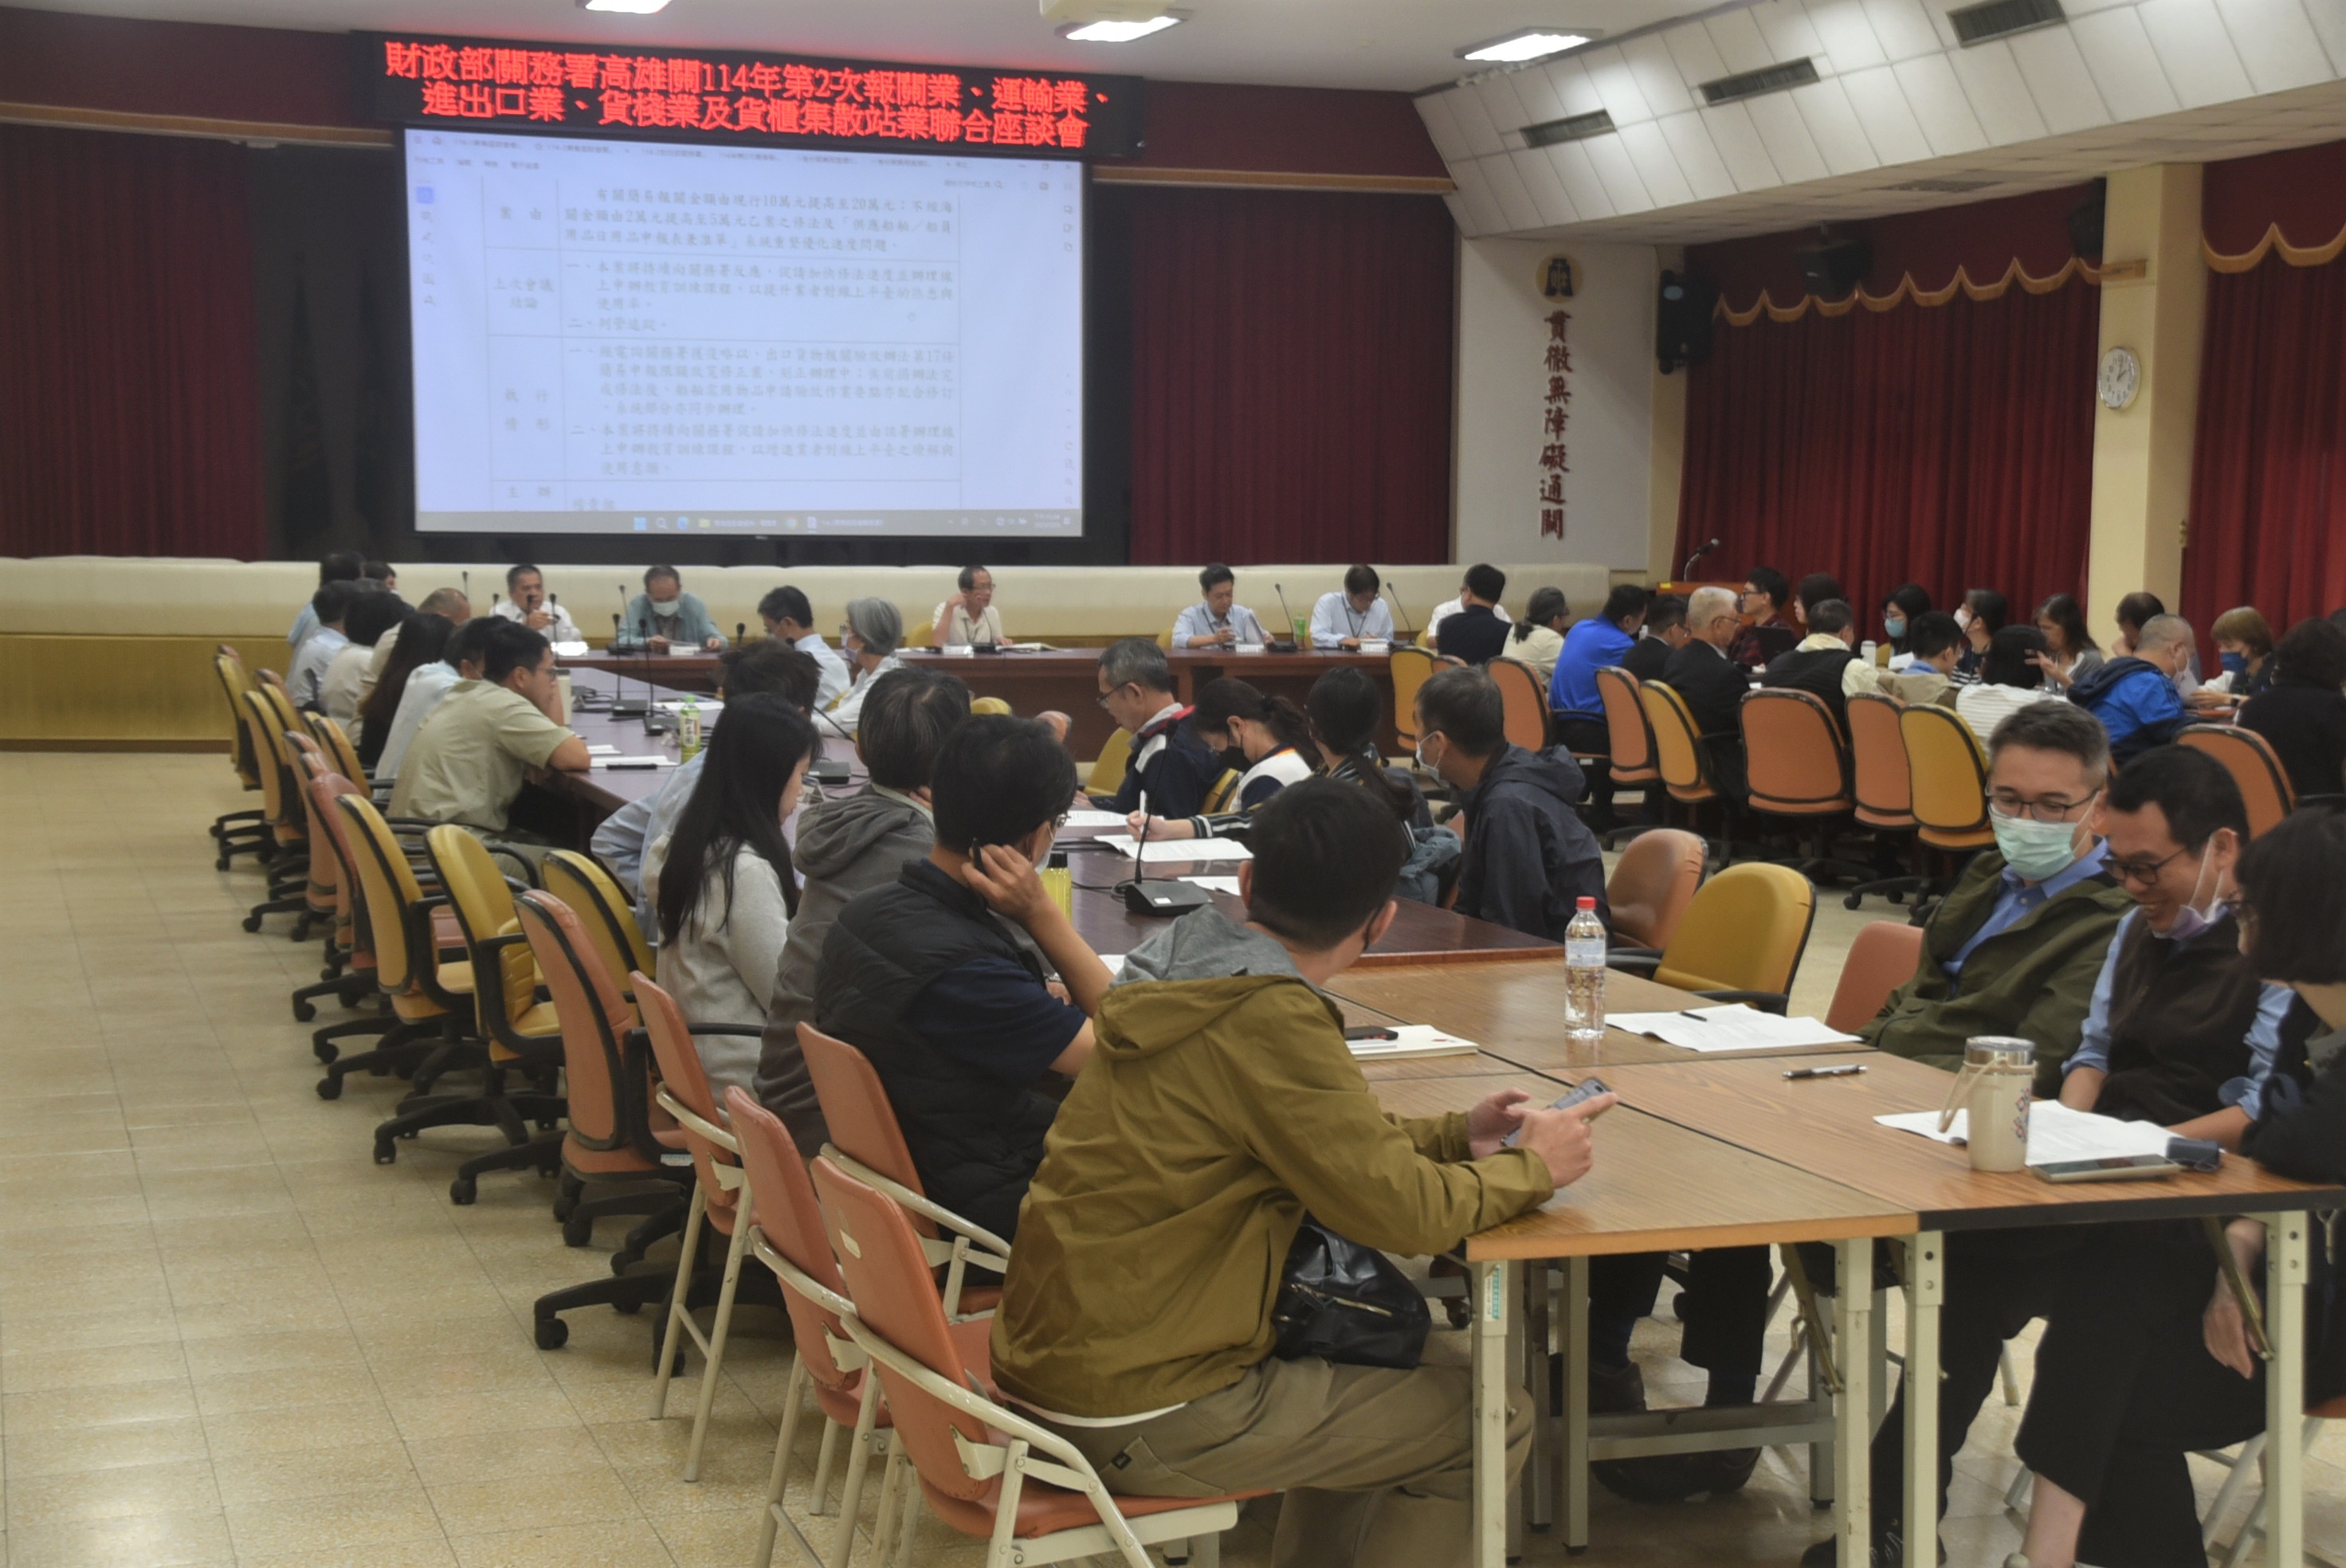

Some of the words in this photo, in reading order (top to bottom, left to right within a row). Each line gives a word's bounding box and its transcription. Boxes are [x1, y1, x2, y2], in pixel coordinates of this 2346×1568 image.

[422, 81, 1091, 148] 進出口業、貨棧業及貨櫃集散站業聯合座談會
[1539, 310, 1574, 541] 貫徹無障礙通關
